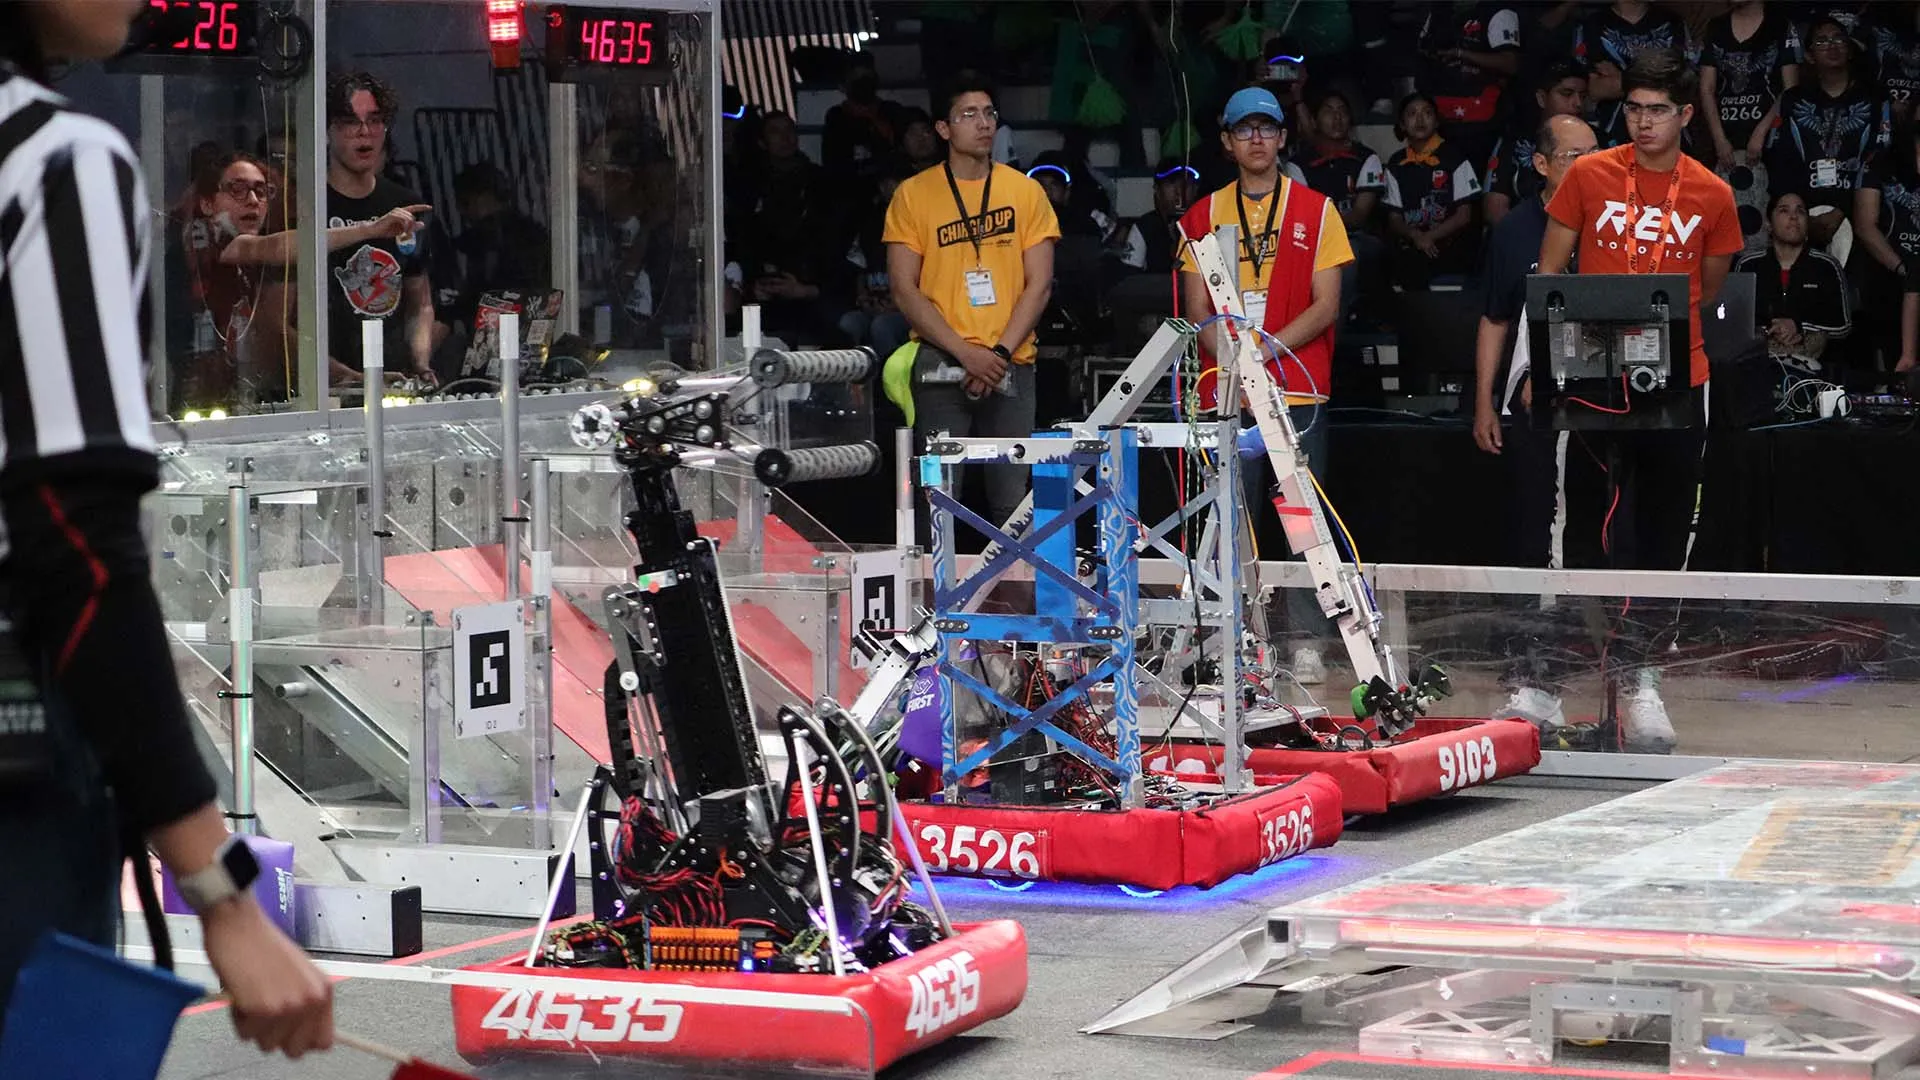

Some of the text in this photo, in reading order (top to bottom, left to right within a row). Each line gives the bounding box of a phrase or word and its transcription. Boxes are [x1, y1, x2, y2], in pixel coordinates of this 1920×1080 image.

[582, 20, 653, 64] 4635
[1721, 95, 1761, 106] OWLBOT
[1721, 106, 1762, 121] 8266
[994, 208, 1013, 231] UP
[1595, 200, 1702, 246] REV
[1597, 239, 1695, 260] ROOICS
[906, 693, 935, 713] FIRST
[1438, 735, 1497, 792] 9103
[921, 824, 1040, 879] 3526
[1260, 805, 1313, 867] 3526
[480, 986, 685, 1043] 4635
[904, 950, 981, 1039] 4635
